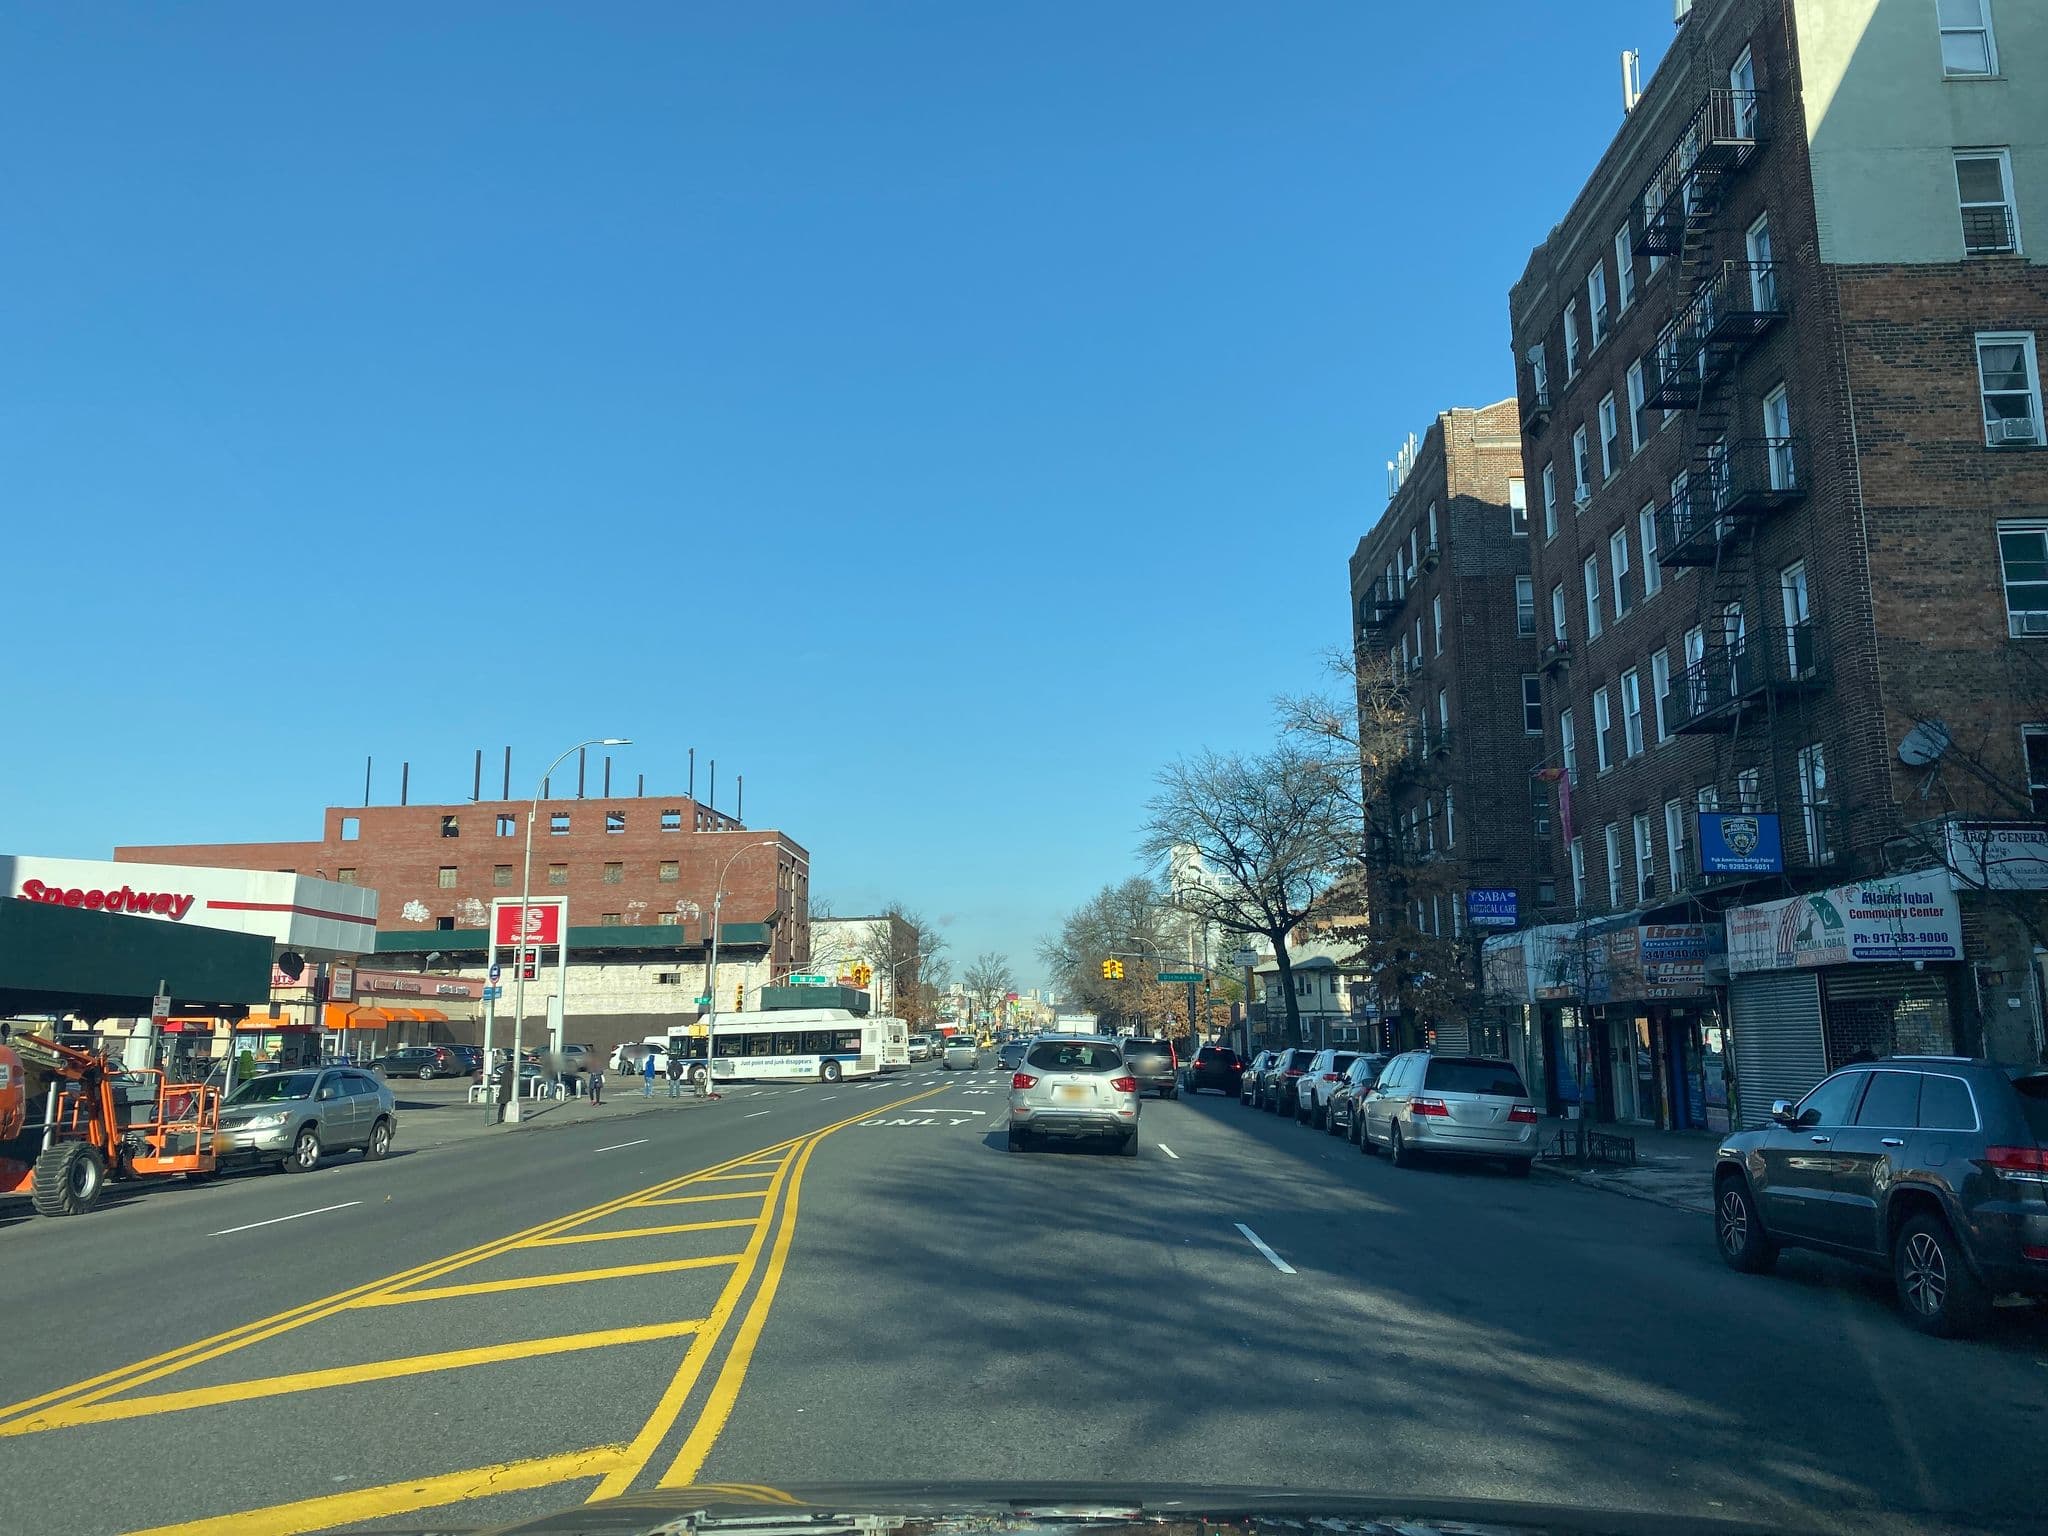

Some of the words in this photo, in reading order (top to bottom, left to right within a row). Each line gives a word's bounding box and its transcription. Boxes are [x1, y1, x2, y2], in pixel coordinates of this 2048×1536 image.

[1998, 832, 2048, 843] GENERA
[17, 879, 195, 920] Speedway
[1478, 891, 1507, 902] SABA
[1904, 891, 1934, 905] Iqbal
[1470, 904, 1499, 914] MEDICAL
[1500, 904, 1517, 914] CARE
[1849, 908, 1908, 919] Community
[1910, 907, 1944, 918] Center
[1854, 933, 1871, 944] Ph:
[1873, 932, 1948, 943] 917-383-9000
[857, 1118, 974, 1127] ONLY
